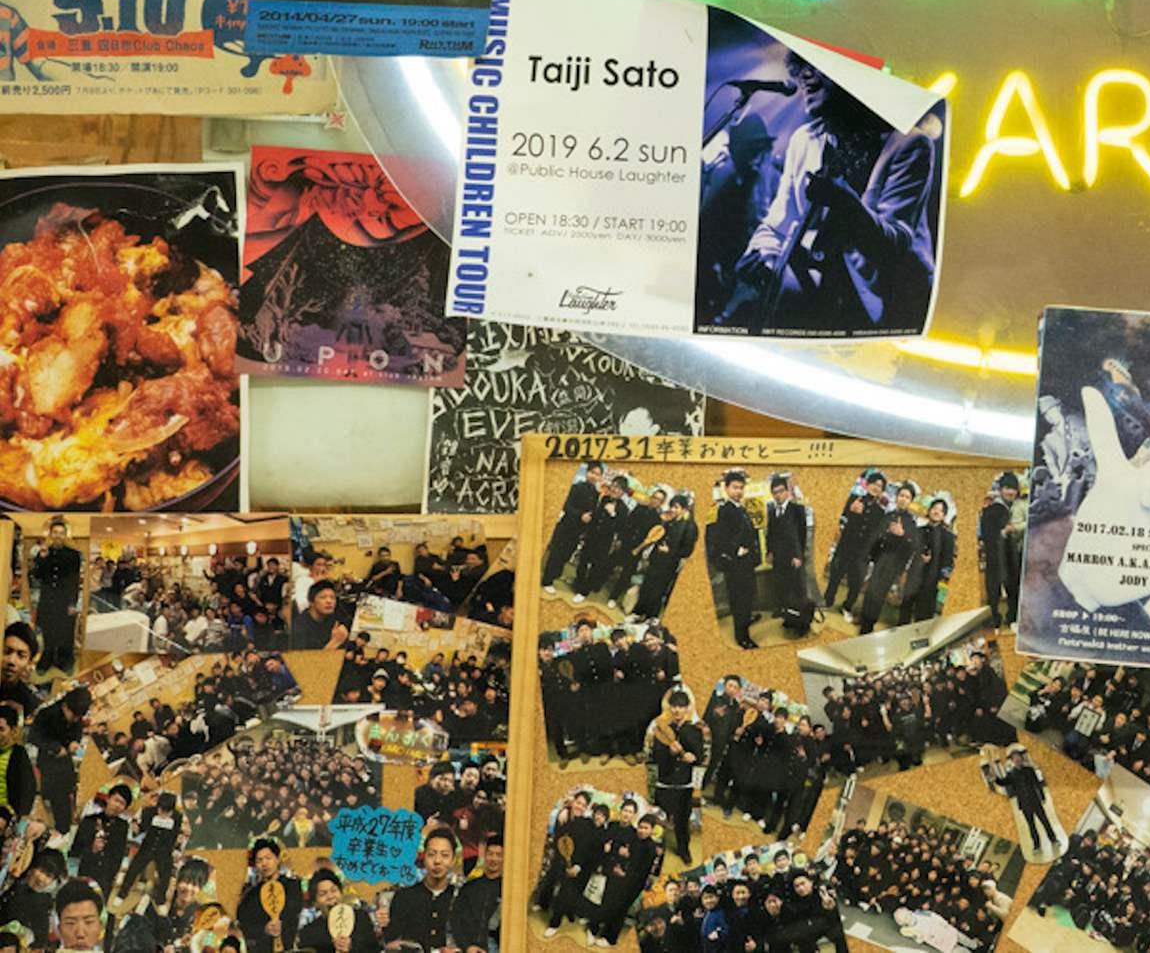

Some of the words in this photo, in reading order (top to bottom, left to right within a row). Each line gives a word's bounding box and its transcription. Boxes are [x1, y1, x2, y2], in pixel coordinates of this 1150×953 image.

[259, 10, 358, 24] 2014/04/27
[528, 55, 591, 91] Taiji
[602, 58, 680, 89] Sato
[511, 132, 578, 158] 2019
[588, 137, 630, 163] 6.2
[638, 144, 688, 165] sun
[460, 95, 499, 239] CHILDREN
[507, 162, 566, 179] @Public
[569, 166, 615, 182] House
[619, 168, 687, 186] Laughter
[505, 212, 547, 226] OPEN
[552, 214, 590, 229] 18:30
[604, 216, 644, 231] START
[650, 218, 688, 234] 19:00
[452, 246, 490, 315] TOUR
[1077, 522, 1145, 538] 2017.02.18
[1066, 552, 1114, 567] MARRON
[1119, 574, 1148, 588] JODY
